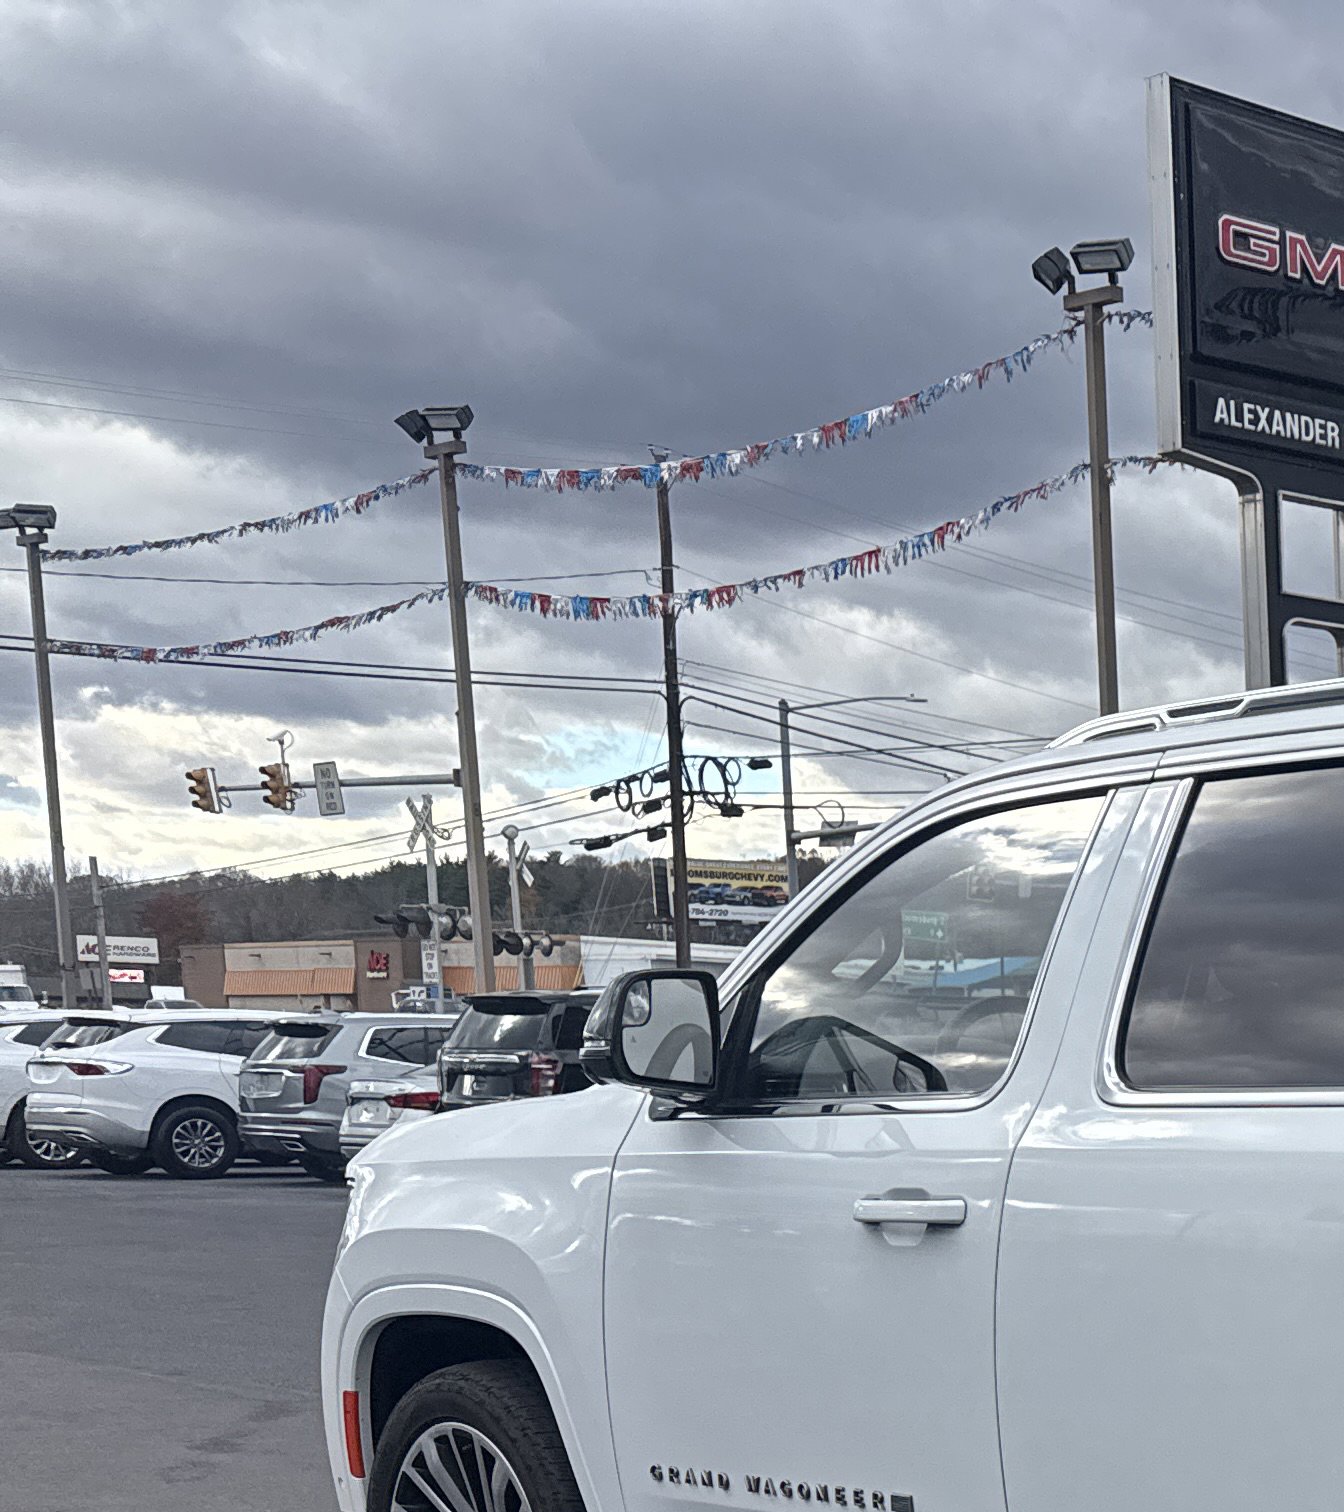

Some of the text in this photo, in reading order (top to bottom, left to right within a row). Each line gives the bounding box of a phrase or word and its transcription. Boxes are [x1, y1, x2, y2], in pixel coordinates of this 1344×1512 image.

[1214, 397, 1340, 449] ALEXANDER
[671, 868, 788, 883] OMSBURGCHEVY.COM
[368, 950, 389, 970] ACE
[649, 1463, 887, 1511] GRAND WAGONEER
